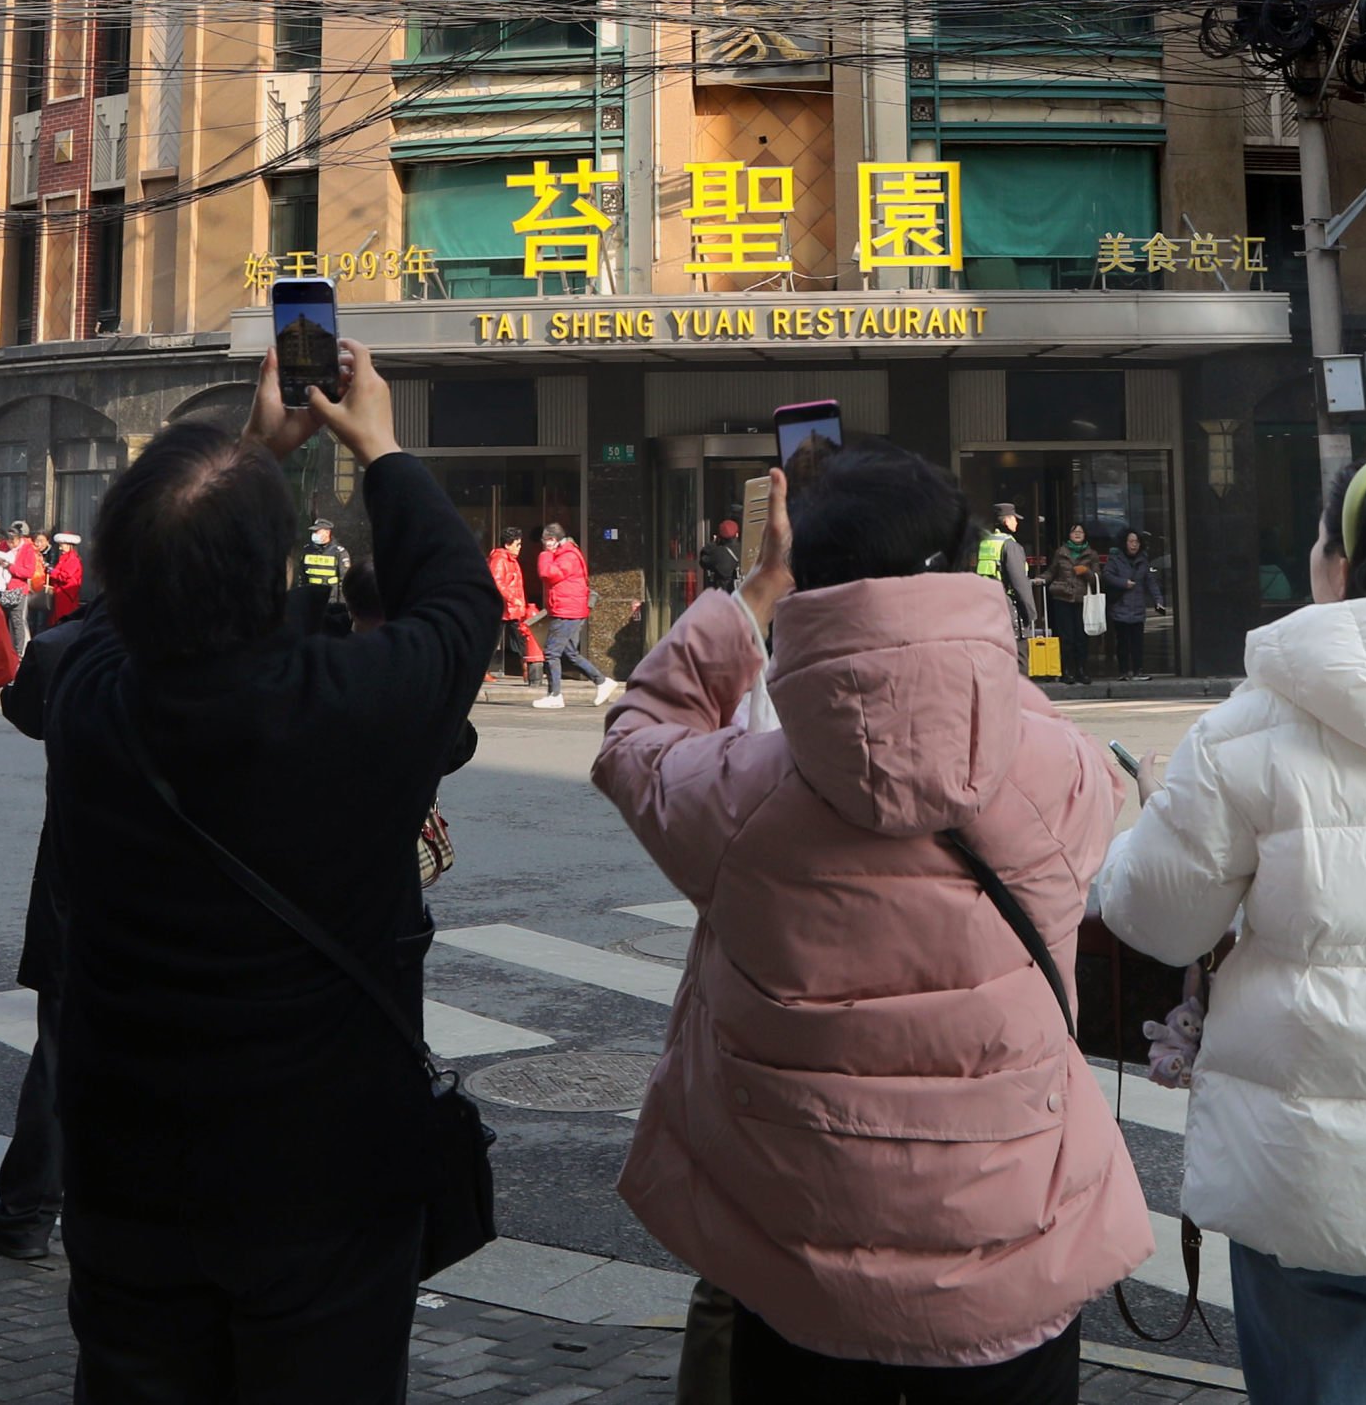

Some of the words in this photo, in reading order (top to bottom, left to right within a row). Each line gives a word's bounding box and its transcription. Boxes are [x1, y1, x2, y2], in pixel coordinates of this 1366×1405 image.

[506, 159, 963, 279] 苔聖園
[243, 245, 438, 290] 始于1993年
[1098, 232, 1268, 273] 美食总汇
[477, 313, 529, 340] TAI
[551, 309, 654, 339] SHENG
[671, 307, 755, 336] YUAN
[773, 306, 988, 336] RESTAURANT
[608, 446, 620, 456] 50
